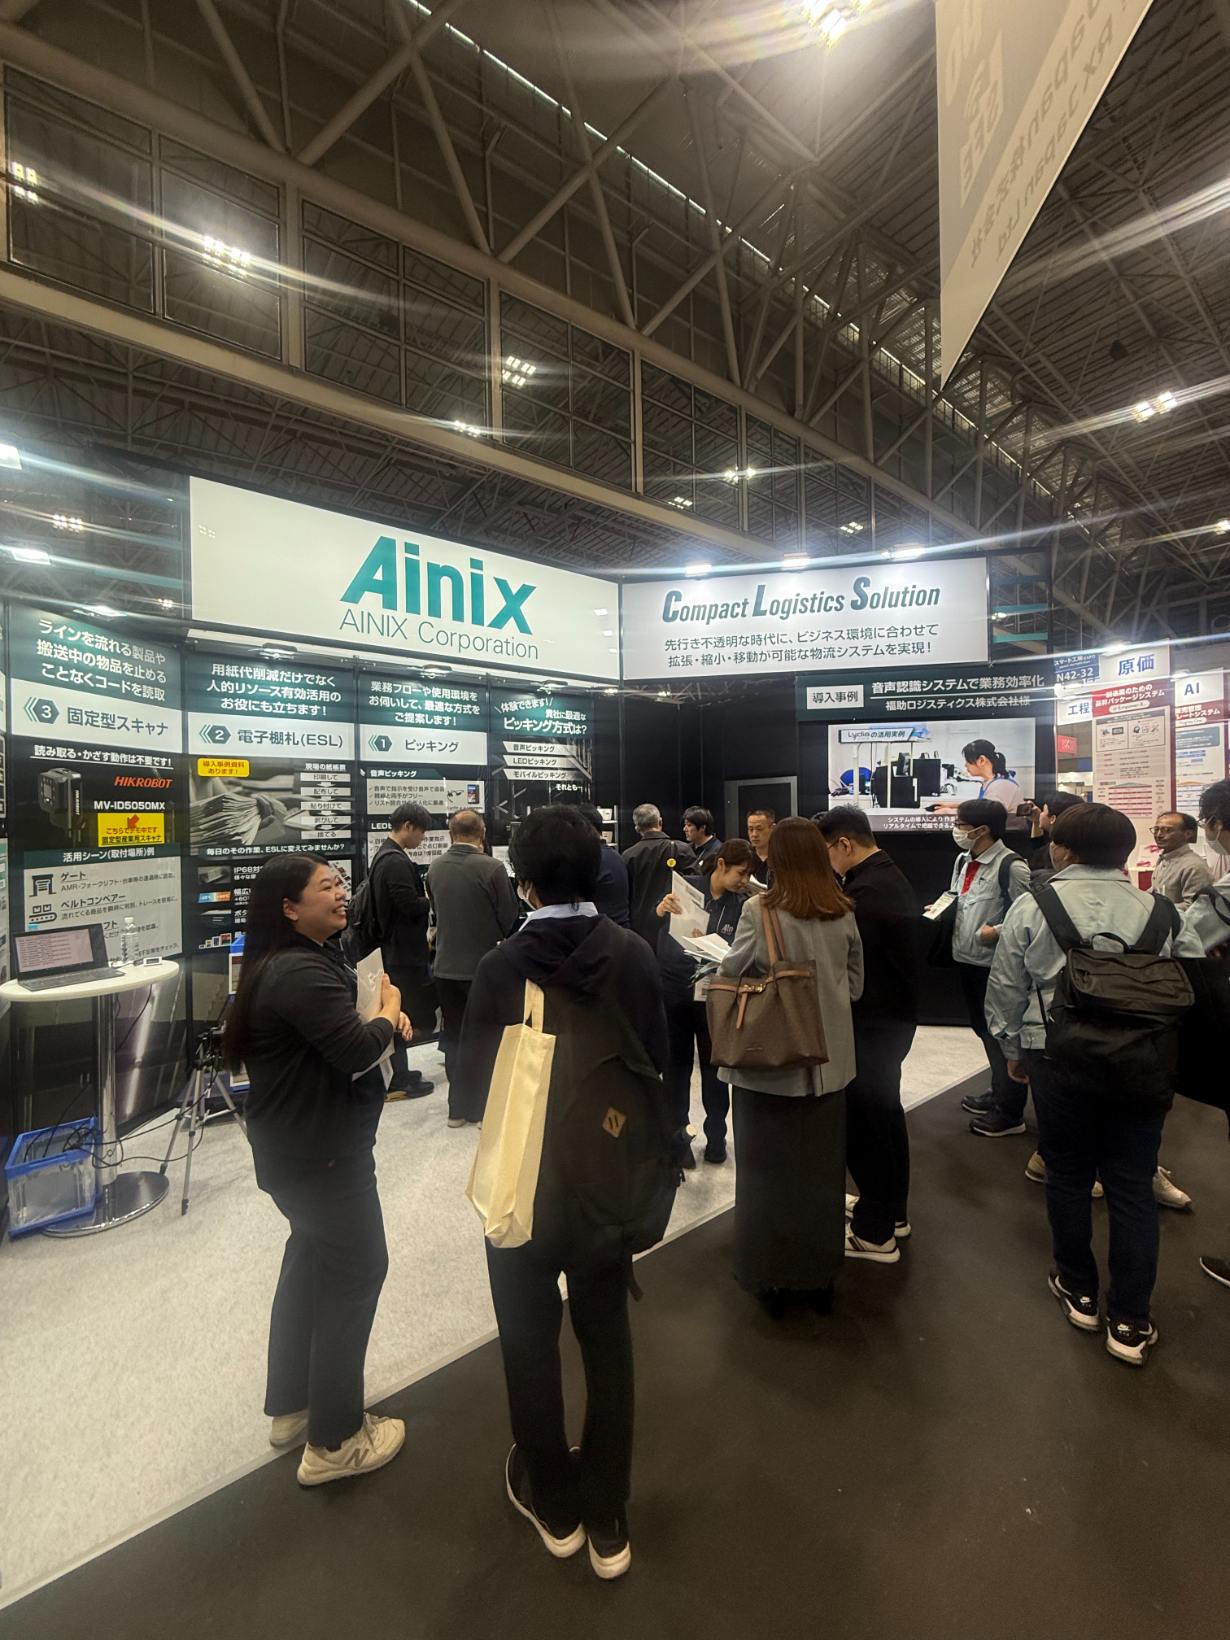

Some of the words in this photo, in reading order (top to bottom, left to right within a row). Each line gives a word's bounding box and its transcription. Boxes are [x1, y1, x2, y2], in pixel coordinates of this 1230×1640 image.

[340, 535, 537, 635] Ainix
[662, 590, 749, 625] Compact
[752, 584, 845, 620] Logistics
[850, 576, 940, 610] Solution
[340, 608, 409, 640] AINIX
[418, 621, 539, 660] Corporation
[665, 624, 939, 651] 先行き不透明な時代に、ビジネス環境に合わせて
[39, 619, 166, 665] ラインを流れる製品や
[37, 639, 167, 683] 搬送中の物品を止める
[1118, 653, 1155, 676] 原価
[42, 663, 165, 701] ことなくコードを読取
[211, 664, 336, 687] 用紙代削減だけでなく
[1056, 667, 1094, 683] N42-32
[206, 680, 341, 702] 人的リソース有効活用の
[370, 681, 478, 702] 業務フローや使用環境を
[871, 675, 1045, 695] 音声認識システムで業務効率化
[1184, 682, 1200, 696] AI
[812, 690, 859, 704] 導入事例
[885, 695, 1031, 711] 福助ロジスティクス株式会社様
[41, 705, 52, 719] 3
[221, 698, 327, 716] お役にも立ちます！
[369, 696, 481, 715] お伺いして、最適な方式を
[1067, 702, 1090, 716] 工程
[67, 707, 168, 736] 固定型スキャナ
[395, 712, 457, 726] ご提案します！
[545, 709, 587, 721] 貴社に最適な
[215, 729, 224, 741] 2
[238, 729, 343, 748] 電子棚札(ESL)
[380, 739, 386, 749] 1
[405, 739, 460, 753] ピッキング
[513, 744, 555, 753] 音声ピッキング
[513, 757, 557, 766] LEDピッキング
[370, 770, 418, 778] 音声ピッキング
[513, 771, 567, 779] モバイルピッキング
[114, 776, 173, 788] HIKROBOT
[93, 801, 165, 810] MV-ID5050MX
[882, 822, 956, 830] リアルタイムで把握できるよ
[60, 871, 87, 882] ゲート
[234, 865, 263, 874] IP68対
[61, 894, 127, 909] ベルトコンベアー
